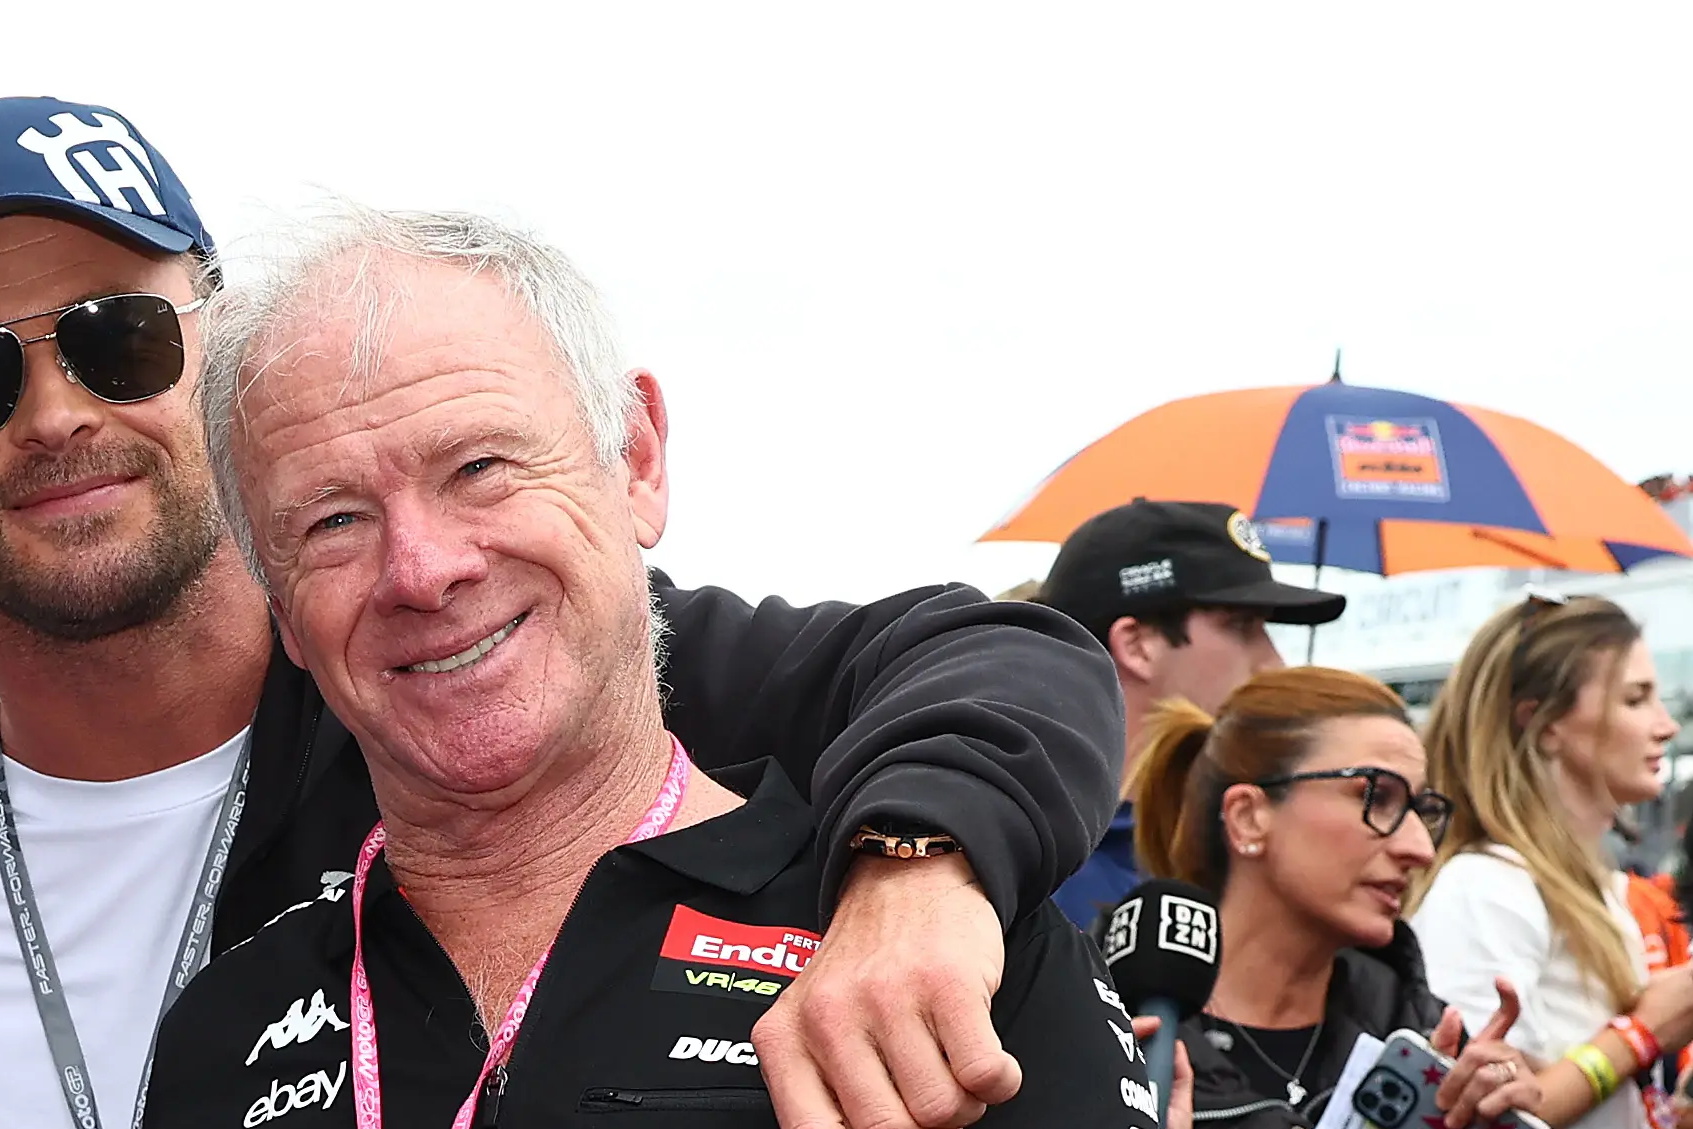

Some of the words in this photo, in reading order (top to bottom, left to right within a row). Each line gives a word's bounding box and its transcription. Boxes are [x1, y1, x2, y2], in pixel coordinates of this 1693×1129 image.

[691, 935, 811, 972] Endu
[668, 1036, 759, 1066] DUC
[243, 1062, 348, 1129] ebay
